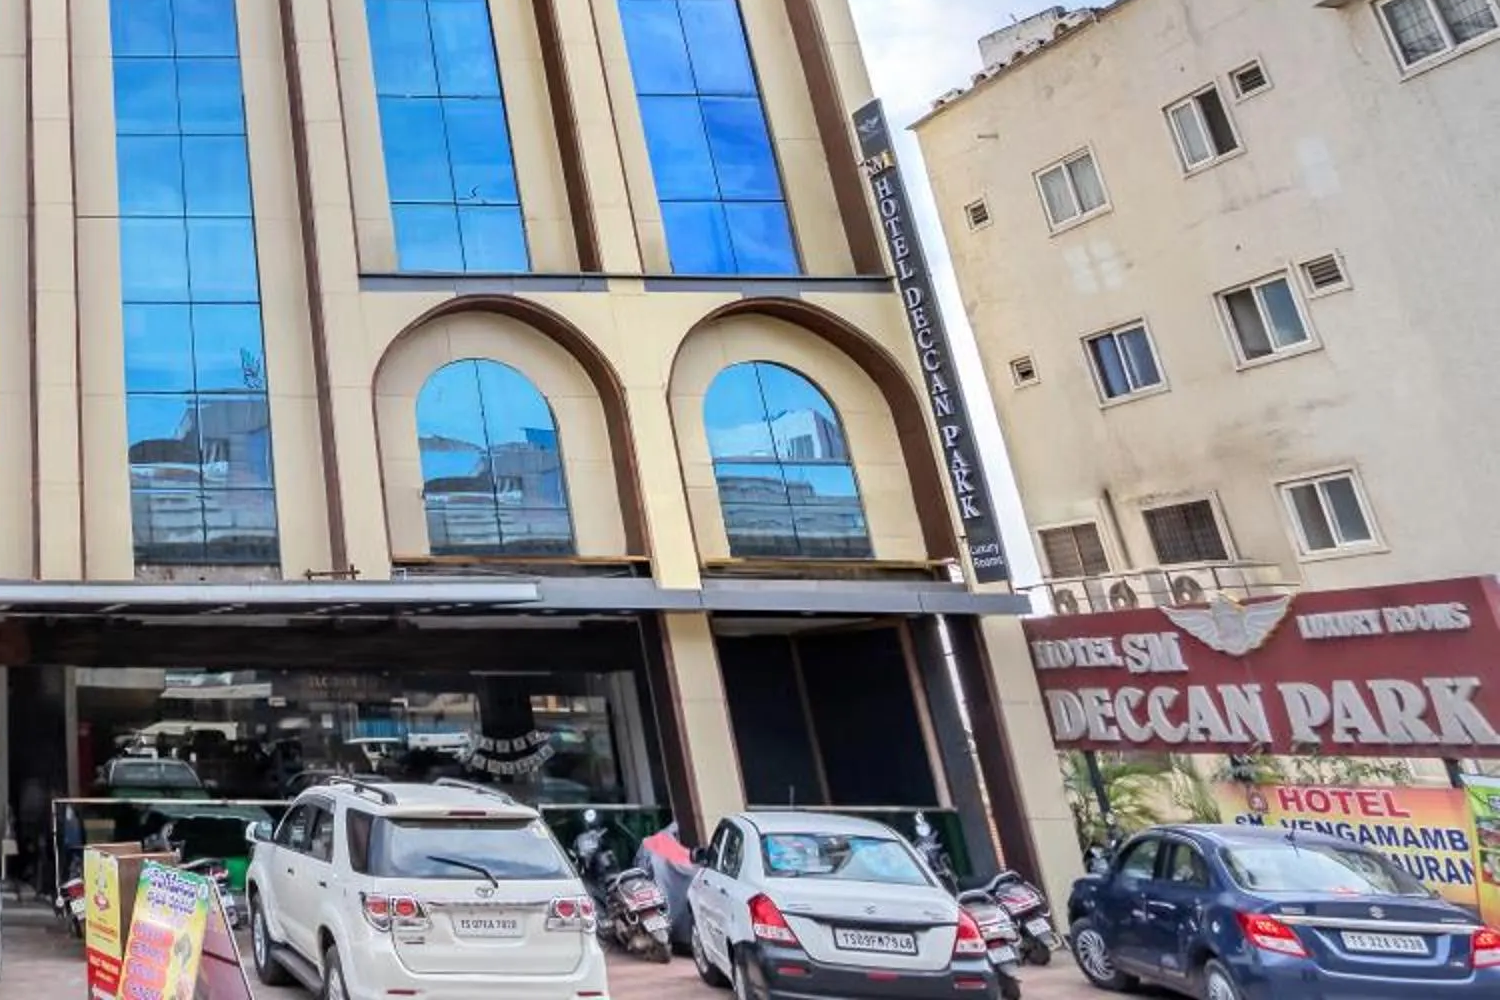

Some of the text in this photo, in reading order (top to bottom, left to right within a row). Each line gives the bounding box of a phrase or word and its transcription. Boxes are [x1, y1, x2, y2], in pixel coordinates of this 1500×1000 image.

[875, 177, 981, 520] HOTEL DECCAN PARK
[1296, 602, 1472, 639] LUXURY ROOMS
[1031, 631, 1189, 674] HOTEL SM
[1044, 676, 1500, 746] DECCAN PARK
[1277, 787, 1410, 819] HOTEL
